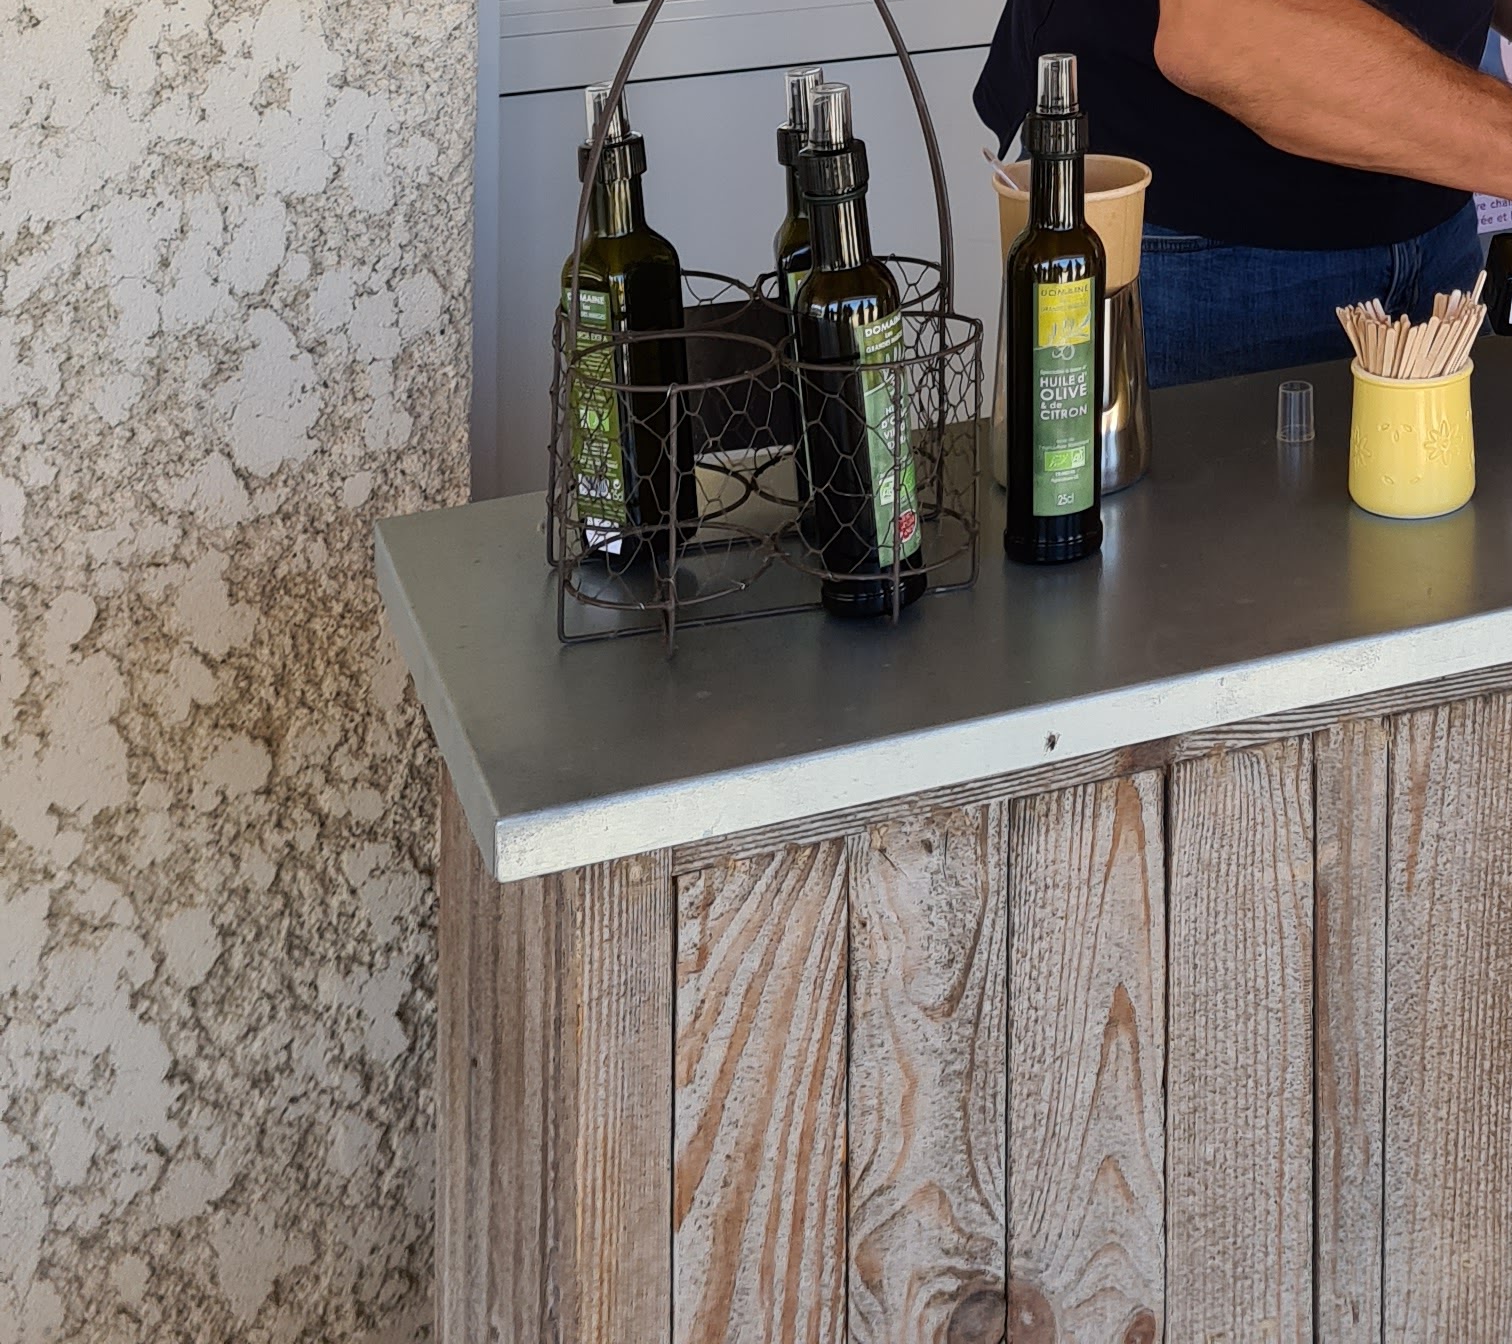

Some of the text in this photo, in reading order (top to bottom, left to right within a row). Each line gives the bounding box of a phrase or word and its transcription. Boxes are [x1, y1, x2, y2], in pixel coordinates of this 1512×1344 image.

[1040, 372, 1087, 388] HUILE d'
[1040, 384, 1087, 401] OLIVE
[1040, 405, 1087, 421] CITRON
[1050, 401, 1062, 409] de
